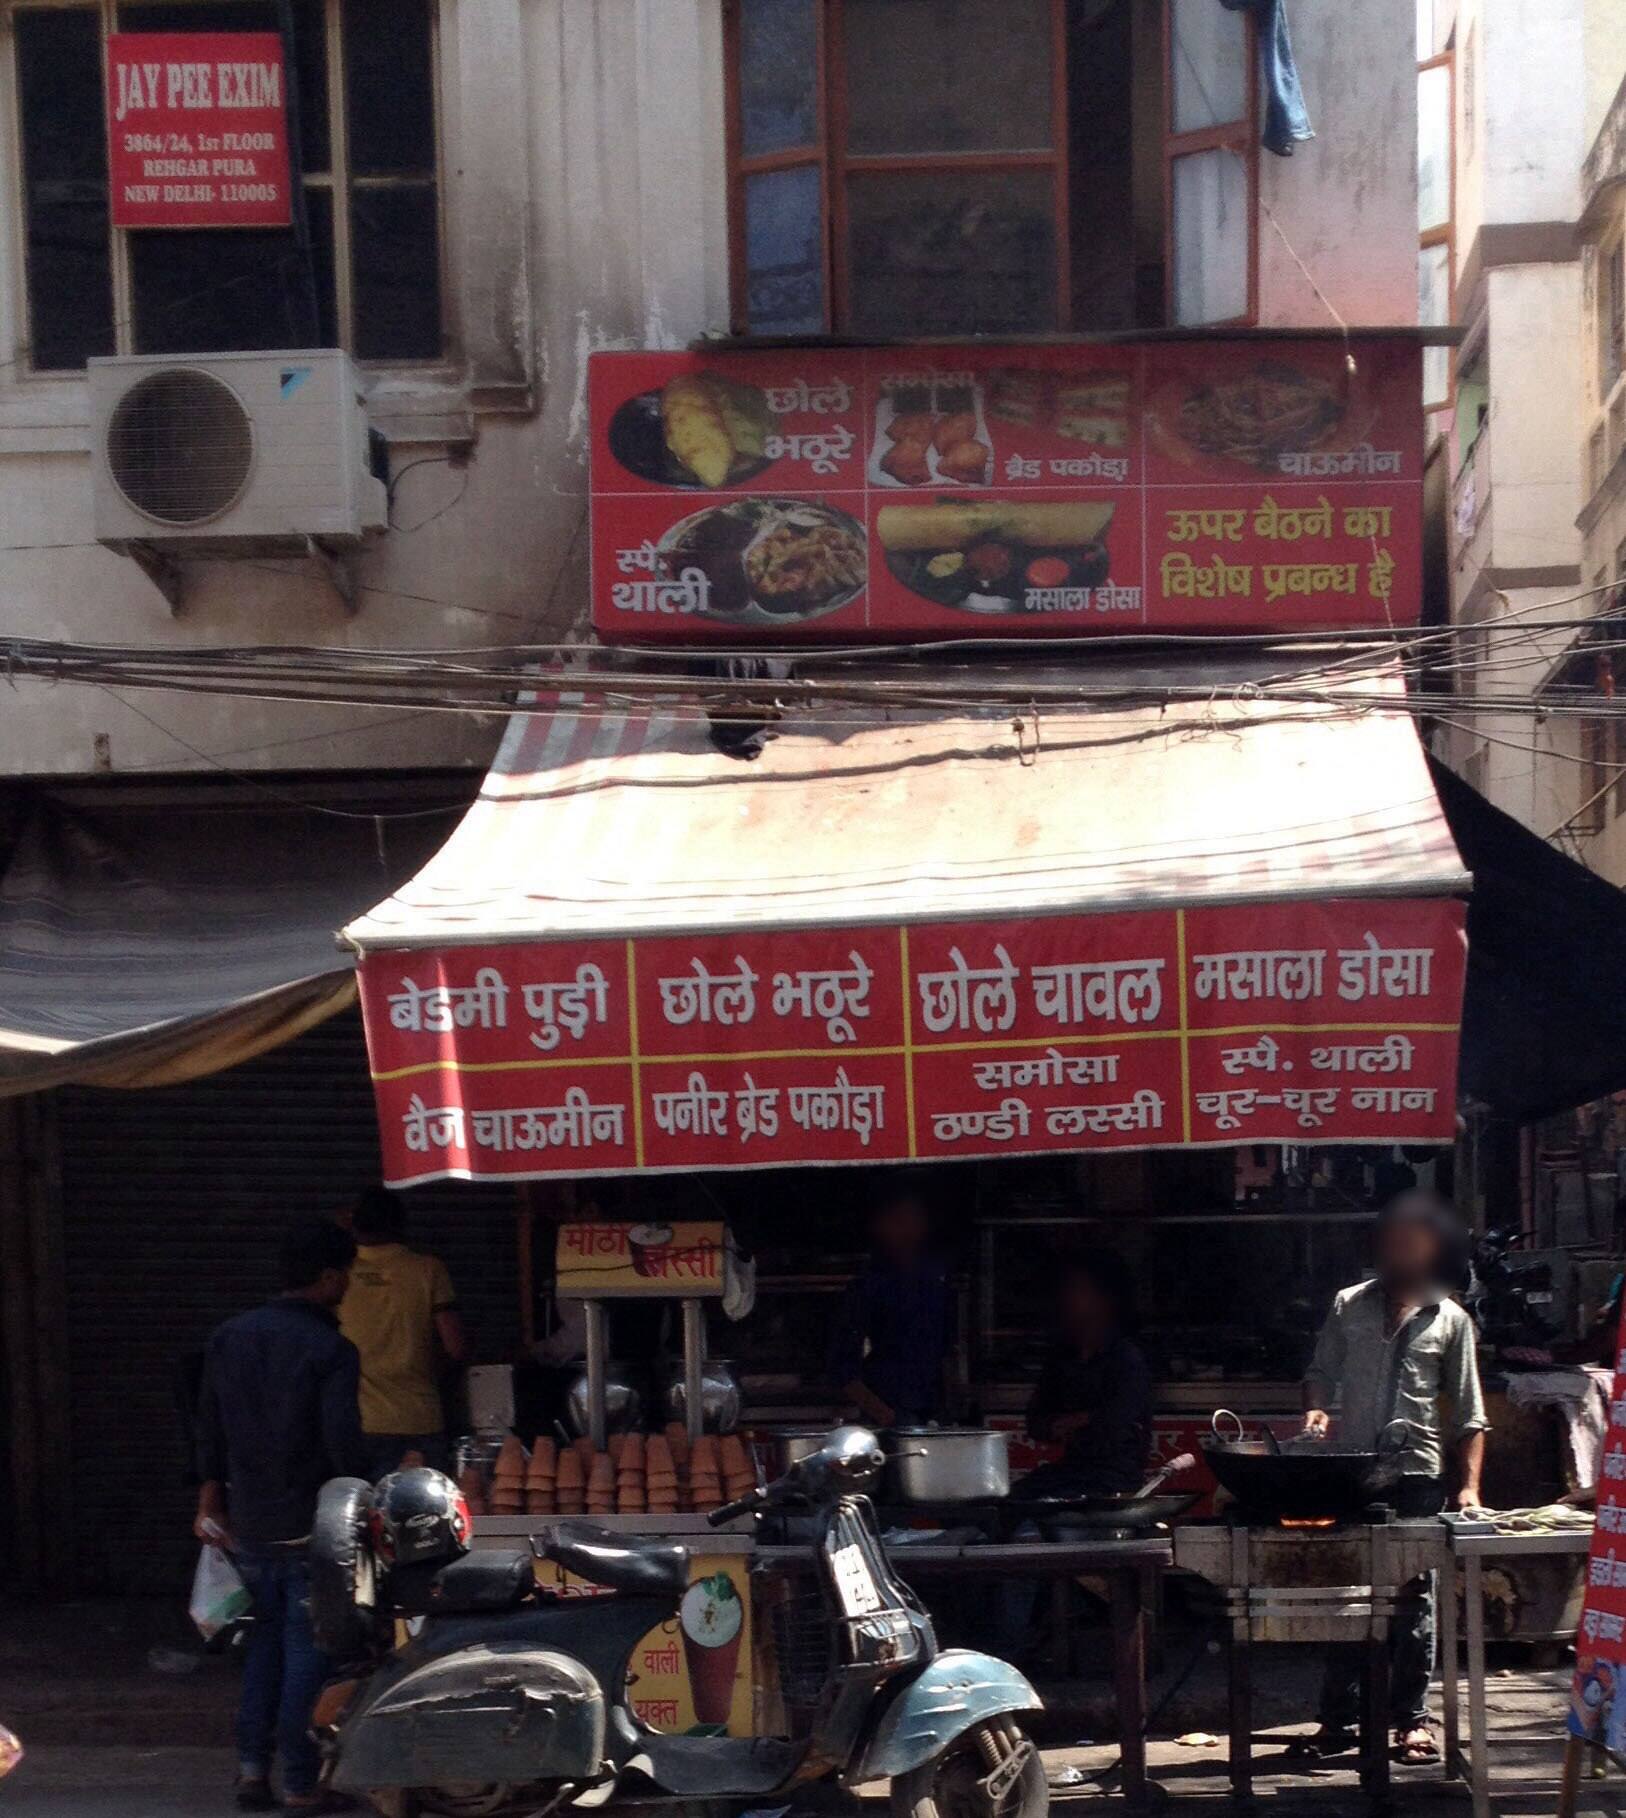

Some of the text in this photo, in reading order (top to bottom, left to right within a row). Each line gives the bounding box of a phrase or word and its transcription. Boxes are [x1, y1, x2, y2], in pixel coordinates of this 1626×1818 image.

[116, 62, 280, 121] JAY PEE EXIM
[223, 132, 275, 150] FLOOR
[143, 158, 257, 177] REHGAR PURA
[125, 185, 160, 203] NEW
[221, 184, 278, 202] 110005
[763, 376, 855, 414] छोले
[765, 424, 857, 474] भठूरे
[1278, 442, 1403, 476] चाऊमीन
[1166, 494, 1392, 542] ऊपर बैठने का
[611, 567, 712, 613] थाली
[1024, 578, 1141, 612] मसाला डोसा
[1160, 548, 1395, 603] विशेष प्रबन्ध है
[918, 943, 1165, 1033] छोले चावल
[1193, 932, 1434, 1001] मसाला डोसा
[387, 963, 610, 1051] बेडमी पुड़ी
[658, 950, 874, 1044] छोले भठूरे
[973, 1048, 1120, 1091] समोसा
[1309, 1035, 1414, 1075] थाली
[402, 1087, 625, 1153] वैज चाऊमीन
[653, 1065, 885, 1146] पनीर ब्रेड पकौड़ा
[932, 1089, 1165, 1141] ठण्डी लस्सी
[1351, 1086, 1438, 1116] नान
[643, 1641, 680, 1675] वाली
